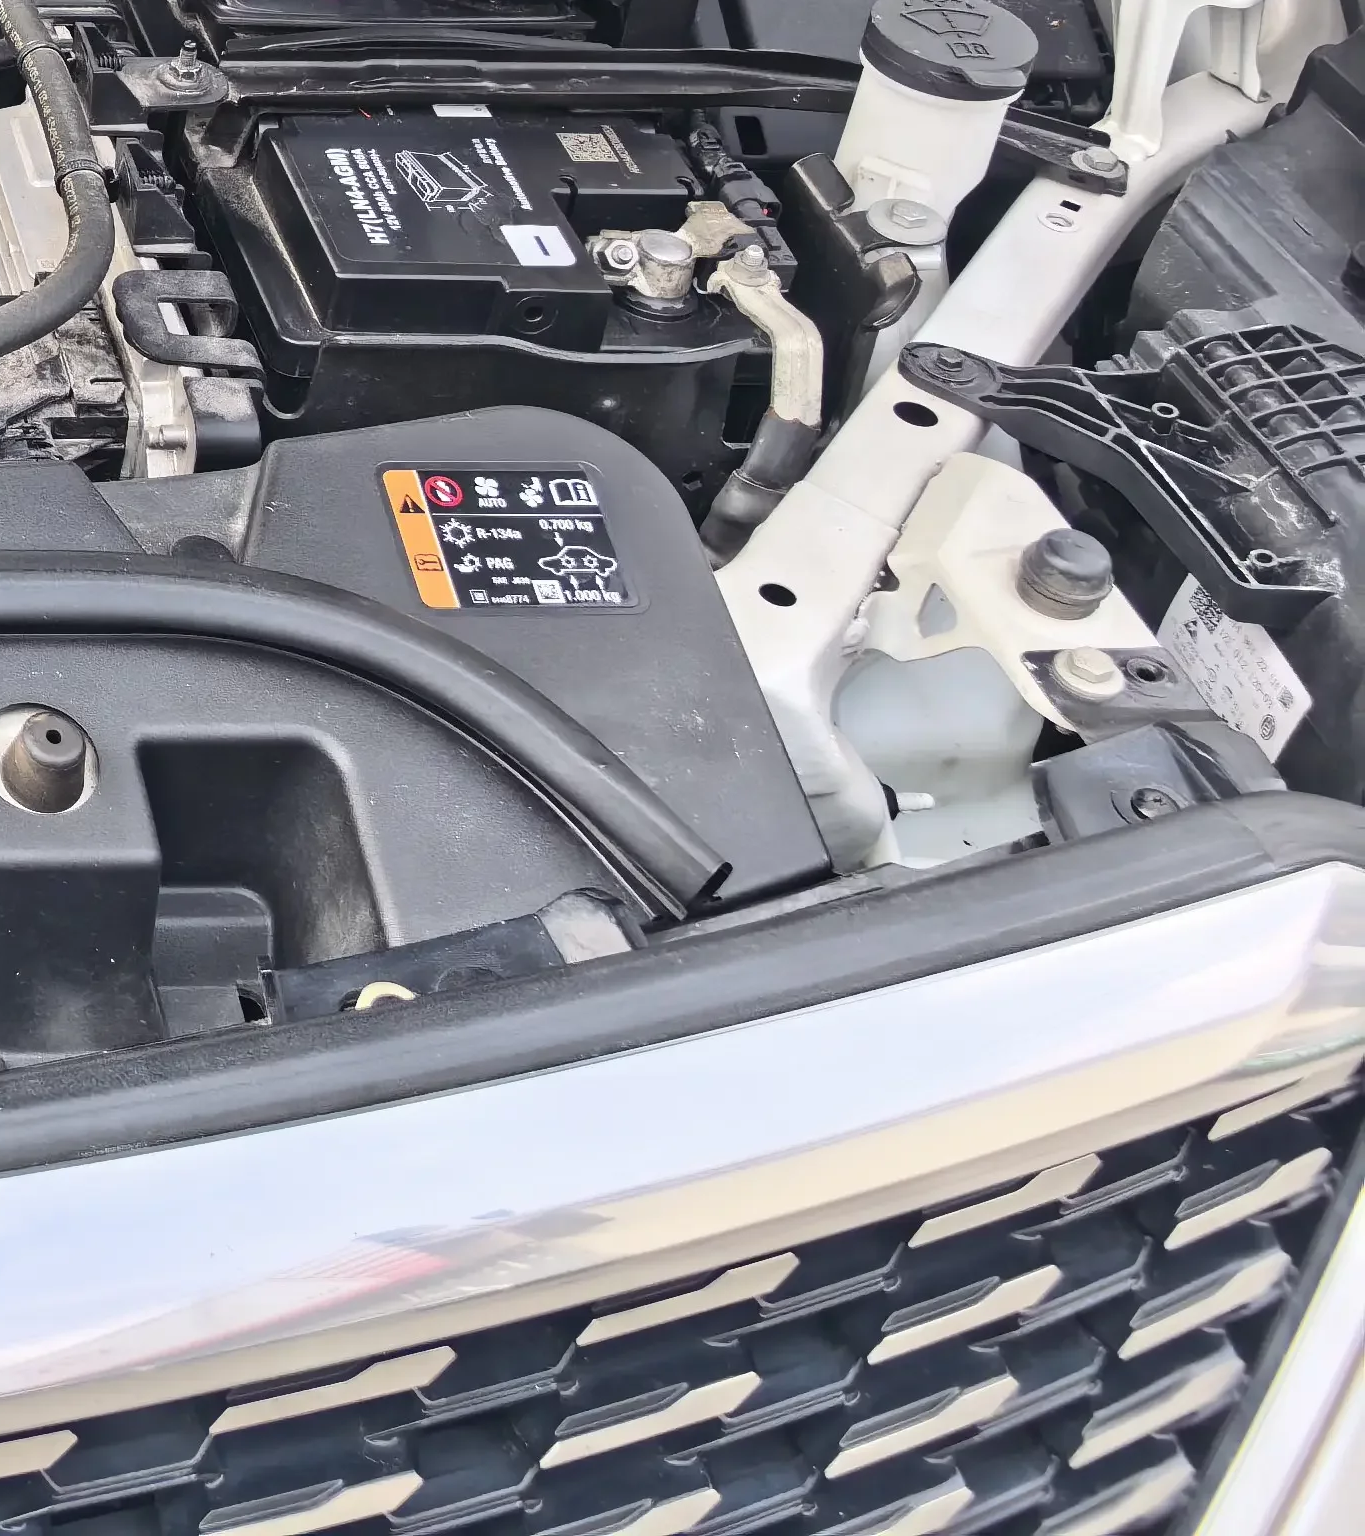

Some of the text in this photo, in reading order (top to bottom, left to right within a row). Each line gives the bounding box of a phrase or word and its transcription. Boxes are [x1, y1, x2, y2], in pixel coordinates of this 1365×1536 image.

[363, 170, 380, 190] CCA
[485, 137, 533, 211] Automotive Battery
[324, 147, 390, 244] H7(LN4-AGM)
[373, 191, 393, 212] 80Ah
[384, 214, 402, 231] 12V
[478, 498, 507, 508] AUTO
[538, 519, 594, 532] 0.700 kg
[476, 528, 523, 540] R-134a
[485, 557, 515, 570] PAG
[564, 588, 622, 604] 1.000 kg
